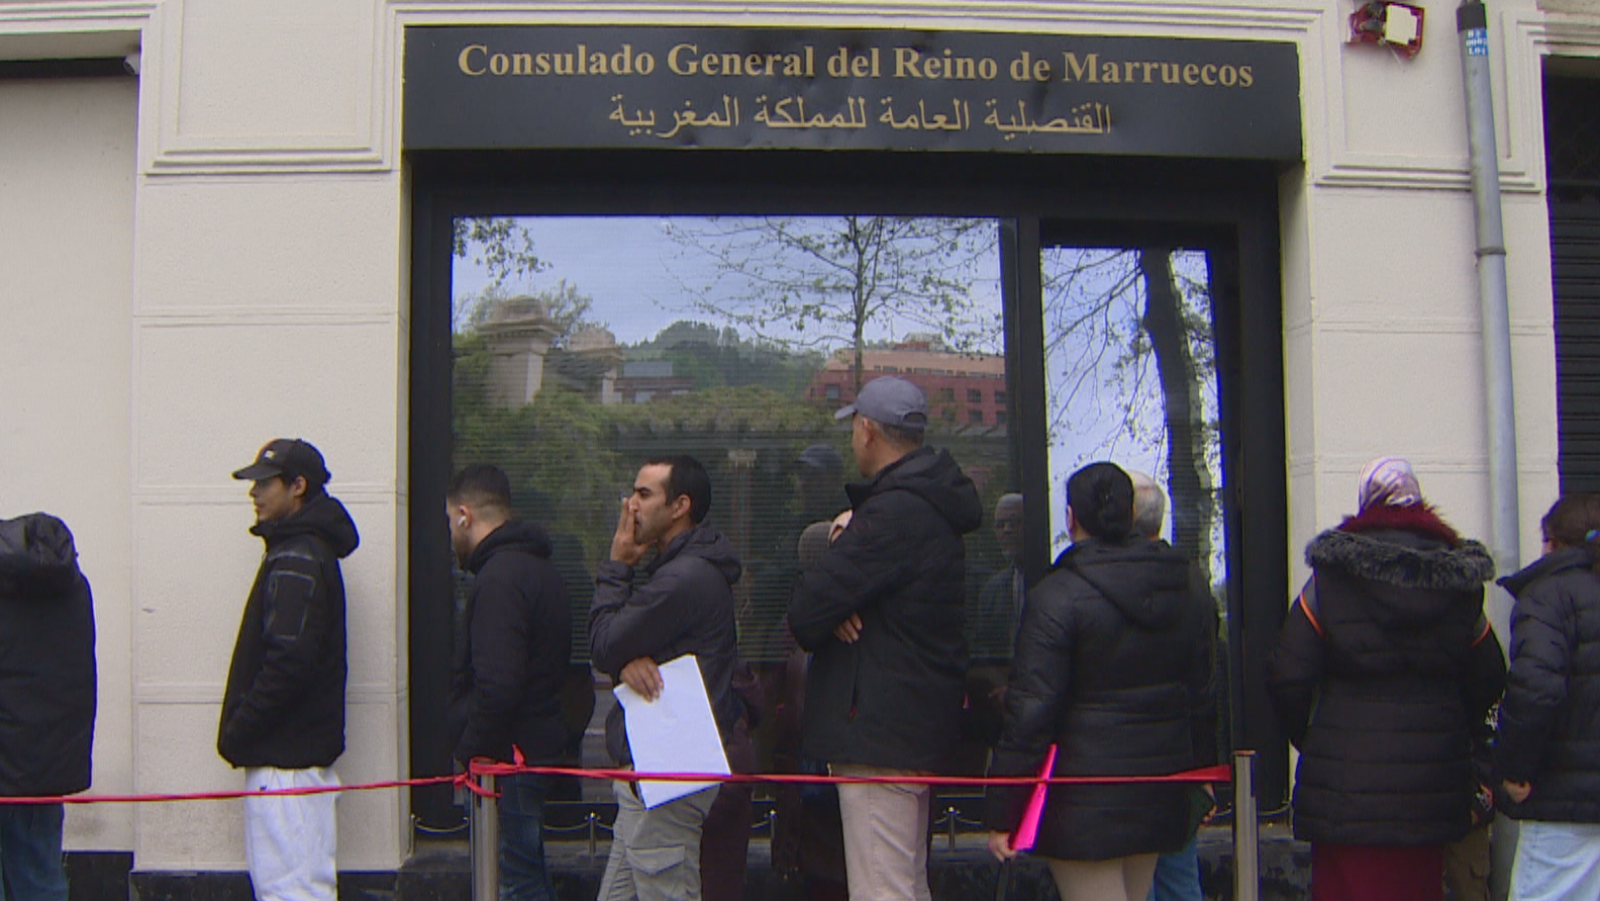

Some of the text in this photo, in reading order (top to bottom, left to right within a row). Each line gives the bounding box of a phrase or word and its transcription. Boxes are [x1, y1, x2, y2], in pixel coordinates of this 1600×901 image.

[458, 43, 1254, 88] Consulado General del Reino de Marruecos
[608, 93, 1112, 141] القنصلية العامة للمملكة المغربية
